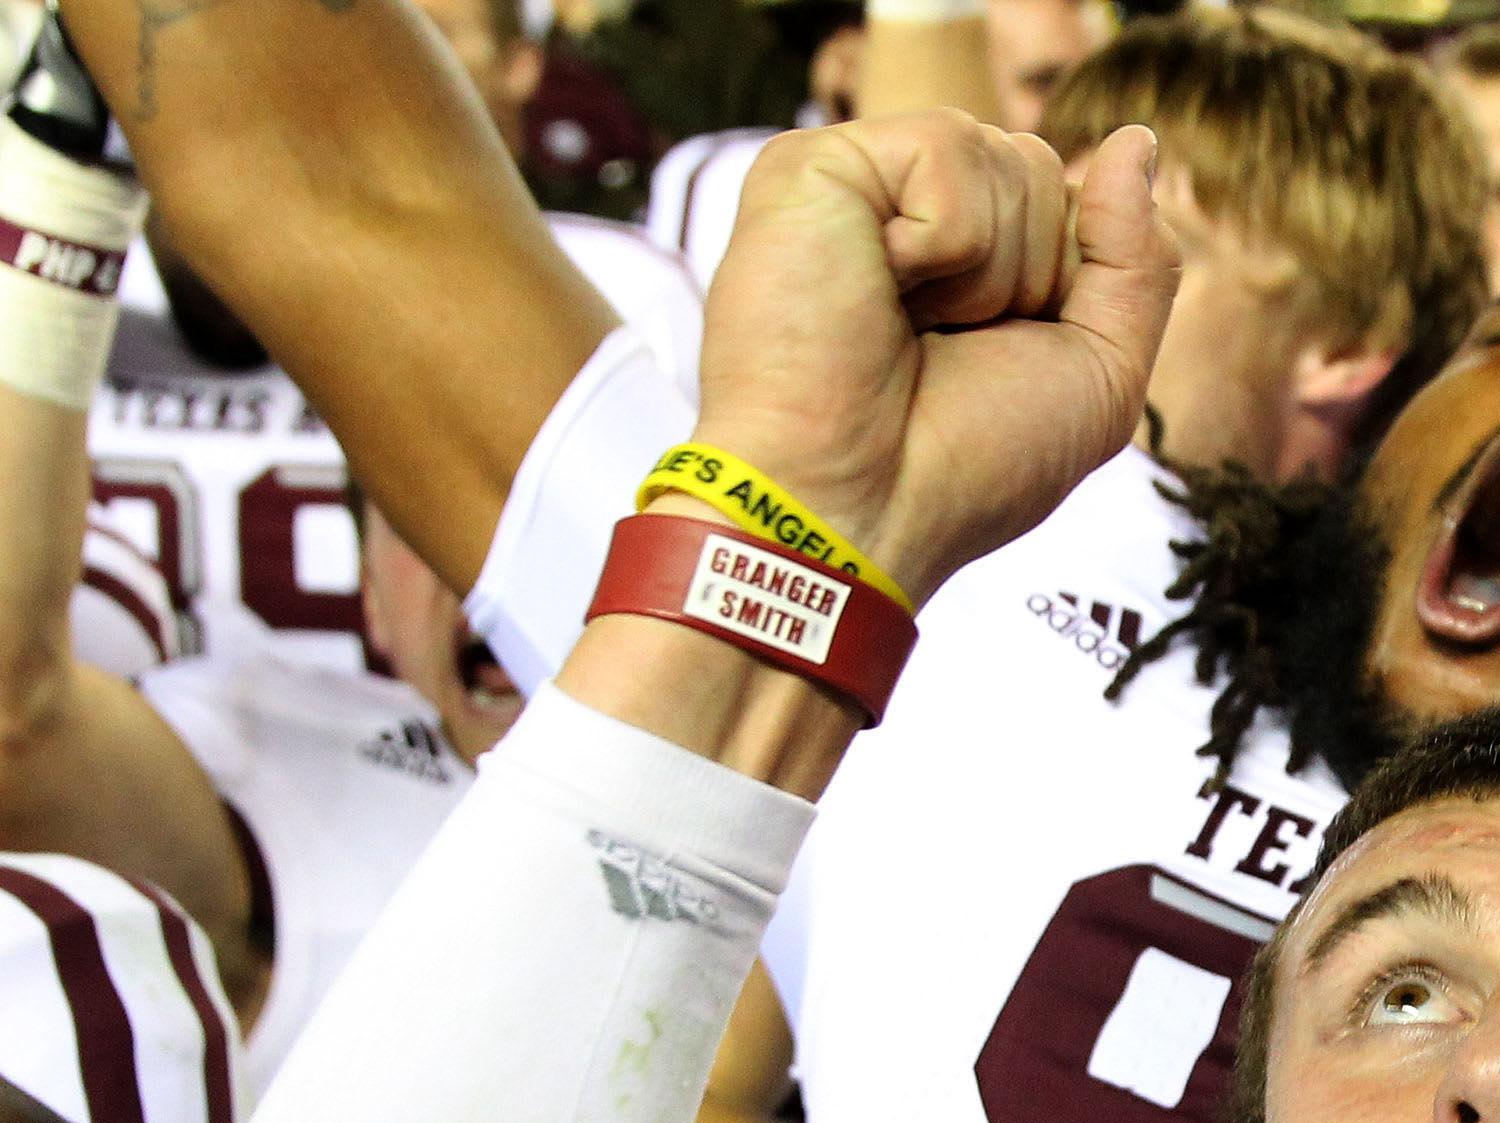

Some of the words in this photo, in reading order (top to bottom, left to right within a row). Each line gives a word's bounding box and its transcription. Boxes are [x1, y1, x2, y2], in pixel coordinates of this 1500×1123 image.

[710, 547, 839, 617] GRANGER
[719, 590, 808, 646] SMITH
[1185, 776, 1318, 894] TE
